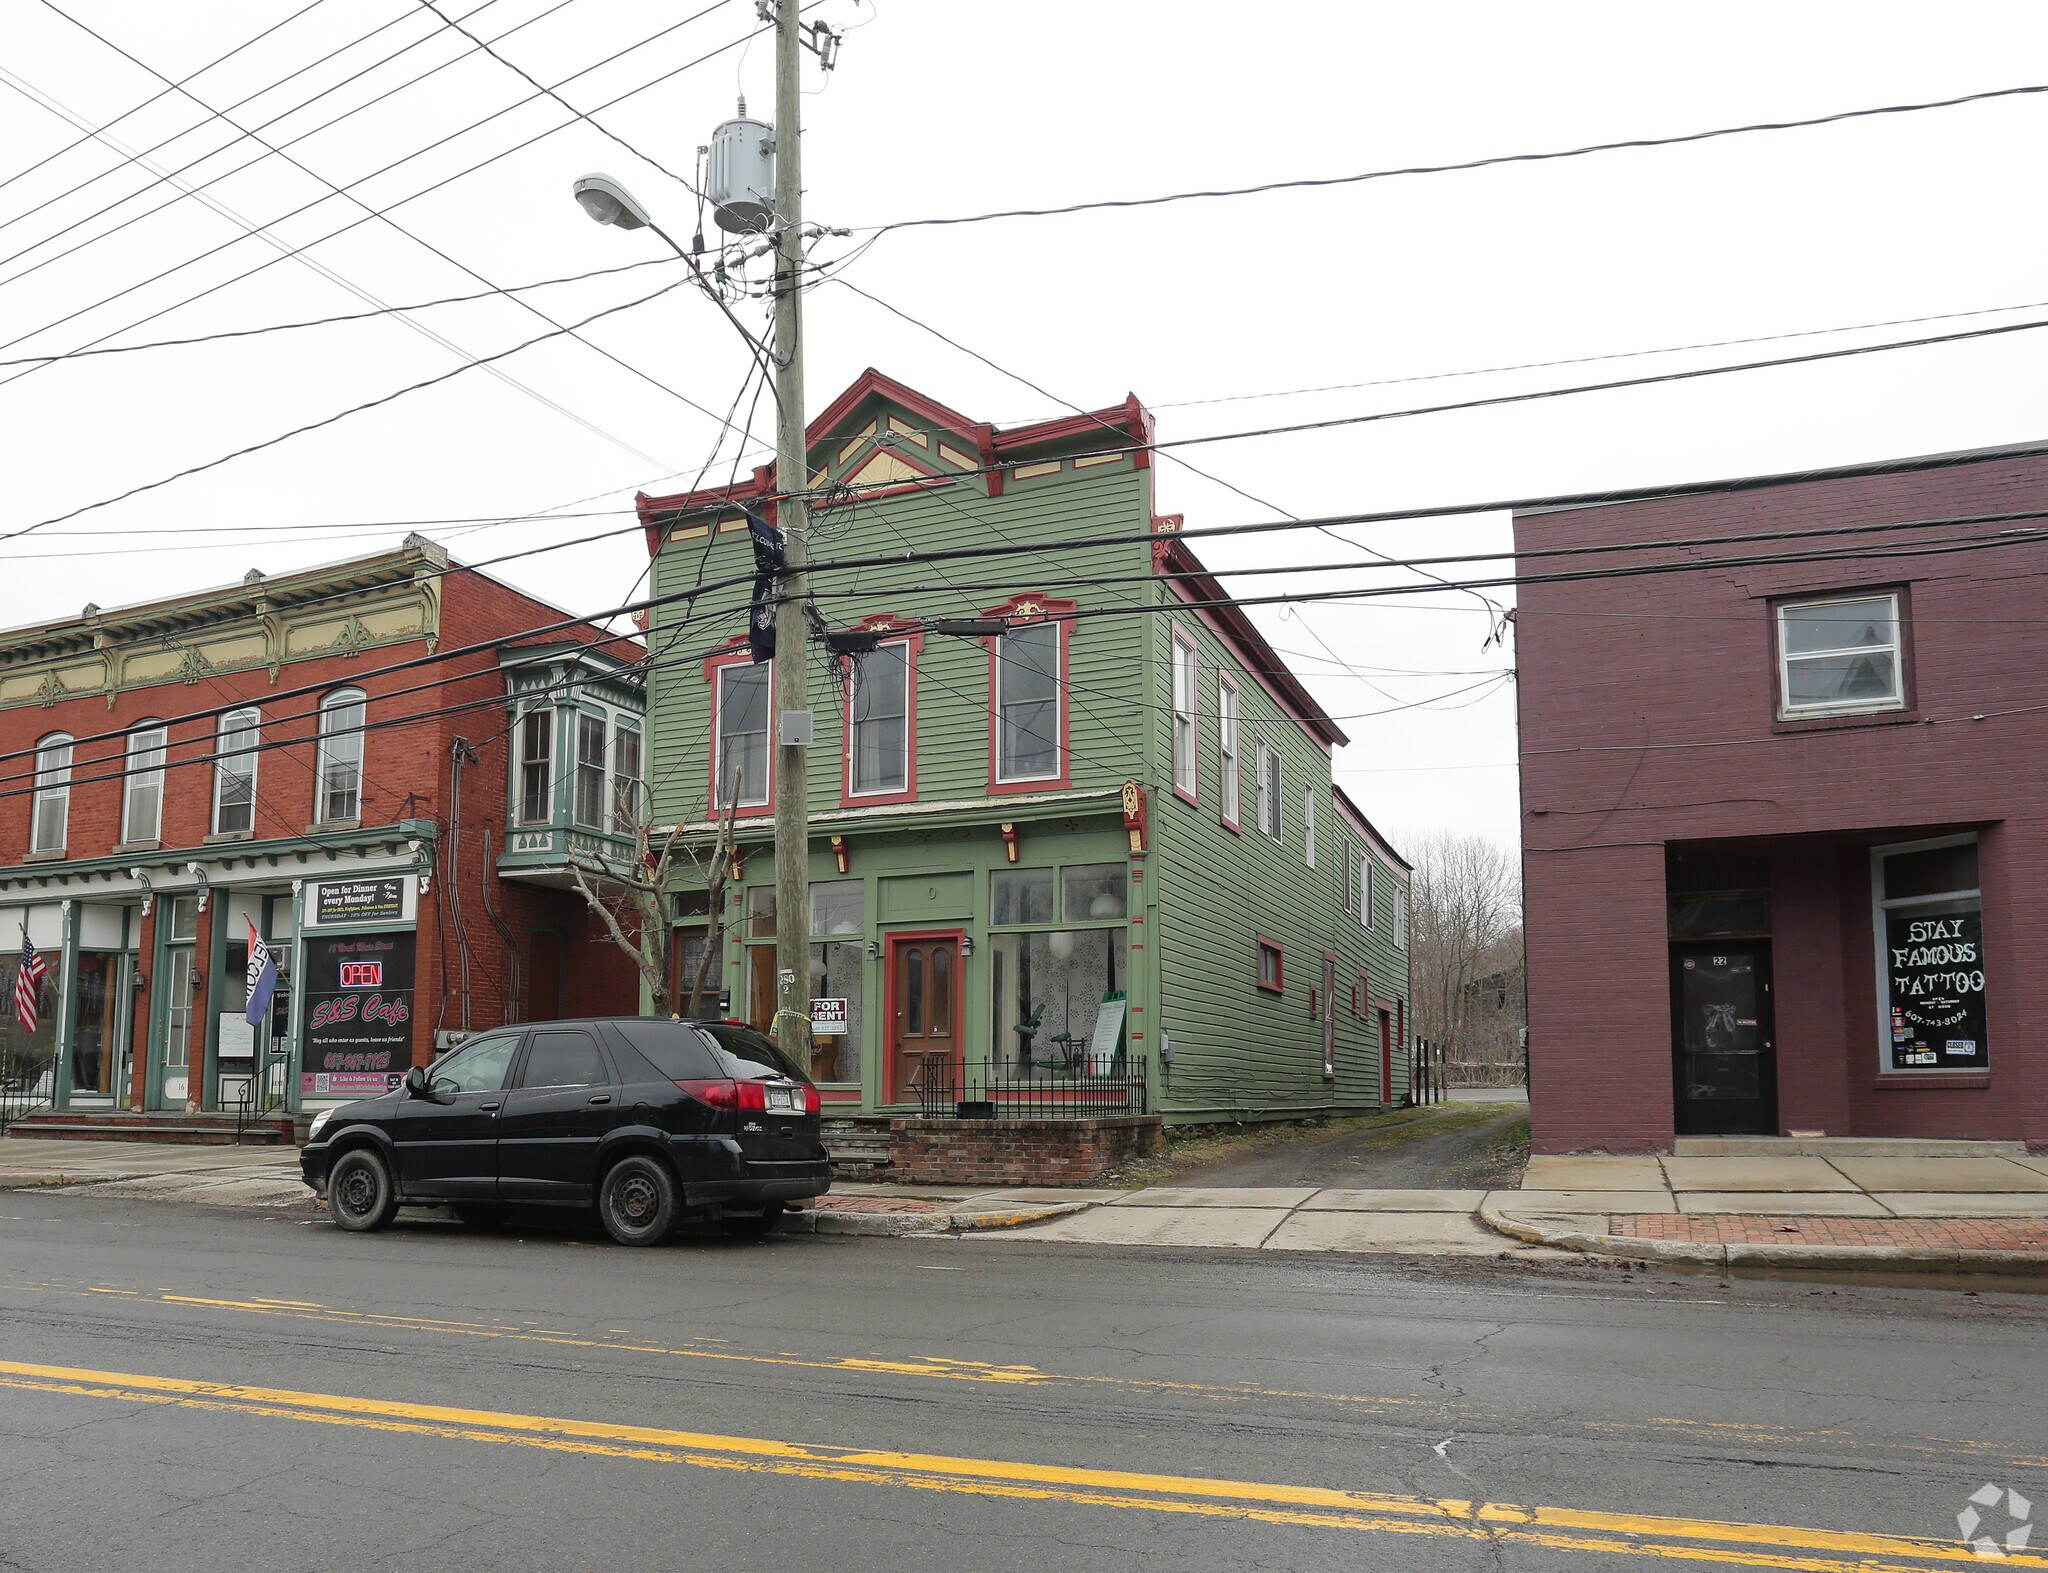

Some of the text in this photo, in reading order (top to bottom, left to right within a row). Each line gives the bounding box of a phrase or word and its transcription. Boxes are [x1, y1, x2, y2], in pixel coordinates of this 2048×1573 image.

[752, 530, 775, 550] ELCOME
[321, 884, 378, 897] Open for Dinner
[323, 894, 375, 906] every Monday!
[1907, 920, 1965, 942] STAY
[1714, 957, 1726, 965] 22
[1892, 943, 1977, 968] FAMOUS
[342, 964, 381, 985] OPEN
[779, 974, 795, 984] 280
[1894, 970, 1985, 995] TATTOO
[783, 985, 790, 994] 2
[310, 993, 409, 1030] S&S Cafe
[814, 1001, 840, 1011] FOR
[811, 1011, 844, 1020] RENT
[178, 1083, 185, 1091] 16
